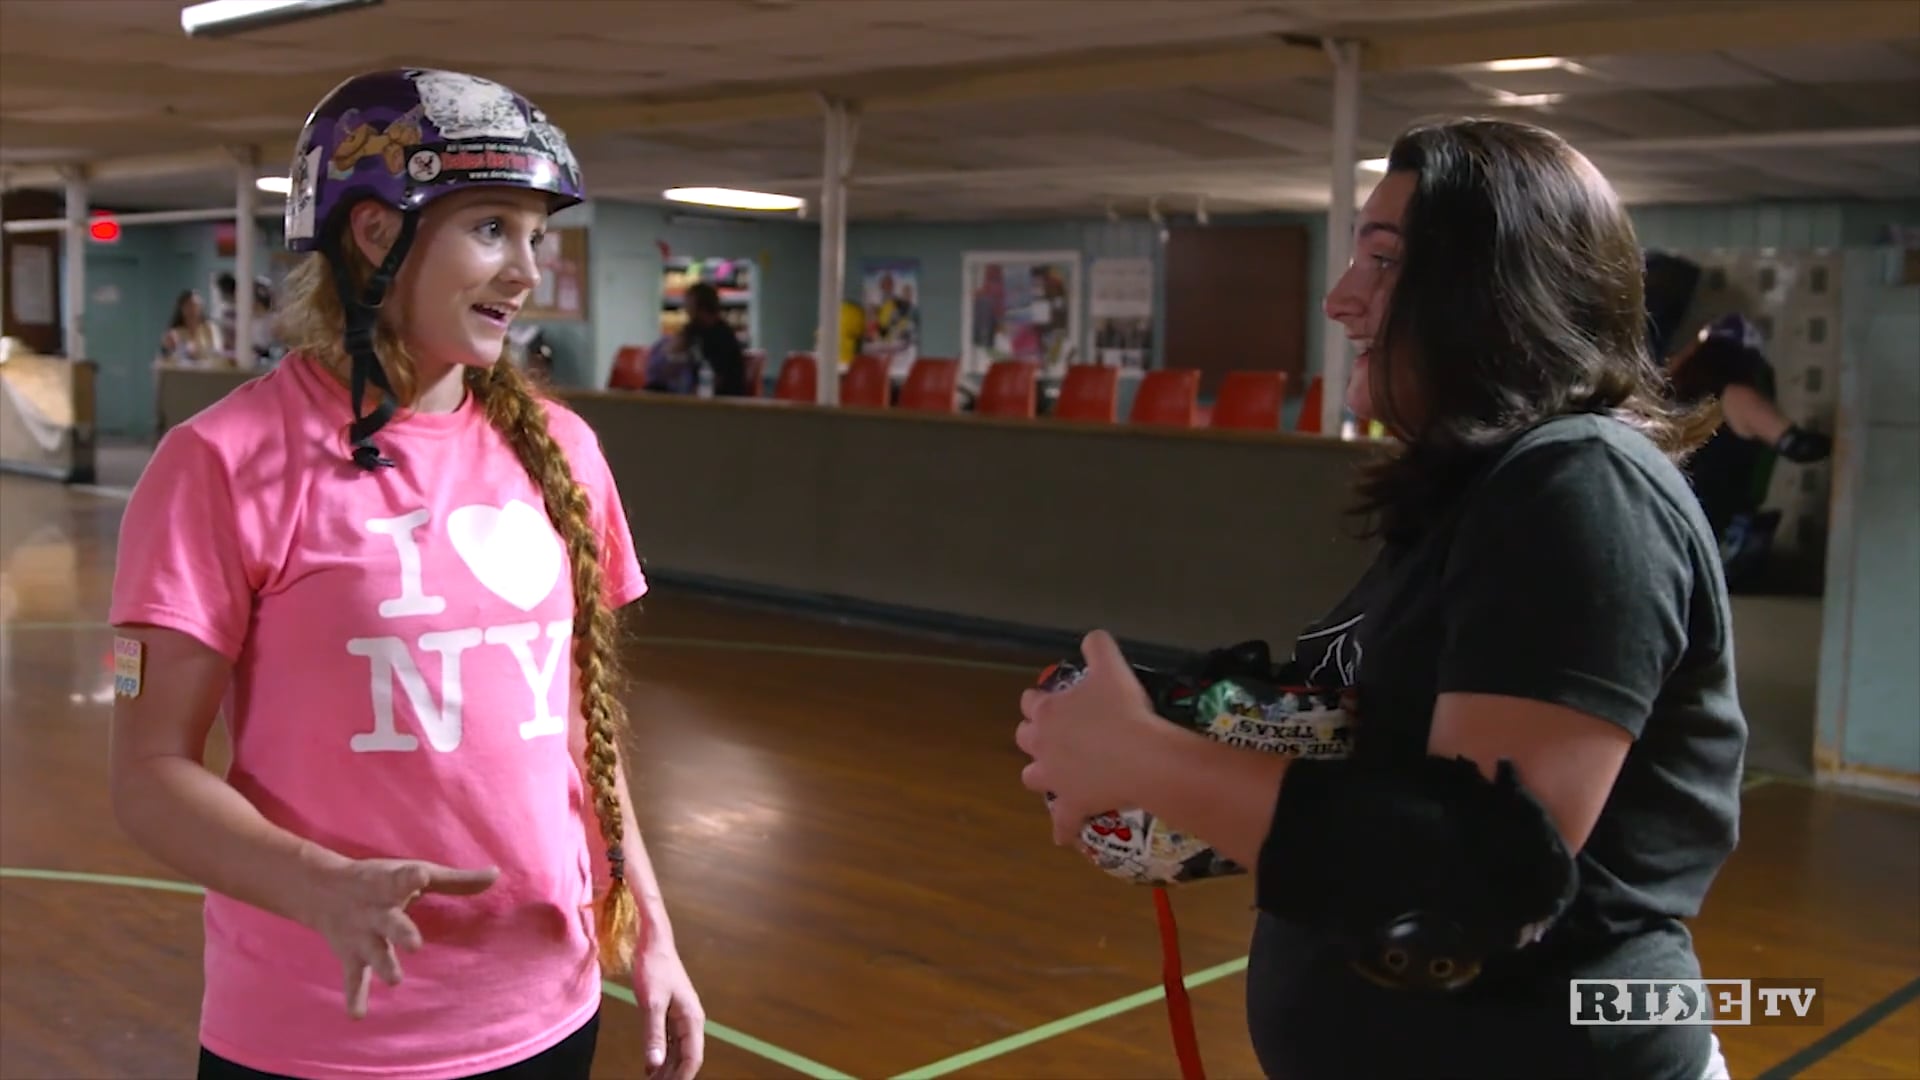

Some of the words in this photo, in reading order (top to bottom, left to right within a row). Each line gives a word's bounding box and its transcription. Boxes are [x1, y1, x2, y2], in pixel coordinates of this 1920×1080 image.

[365, 508, 447, 618] I
[346, 619, 574, 753] NY
[1239, 719, 1315, 739] TEXAS
